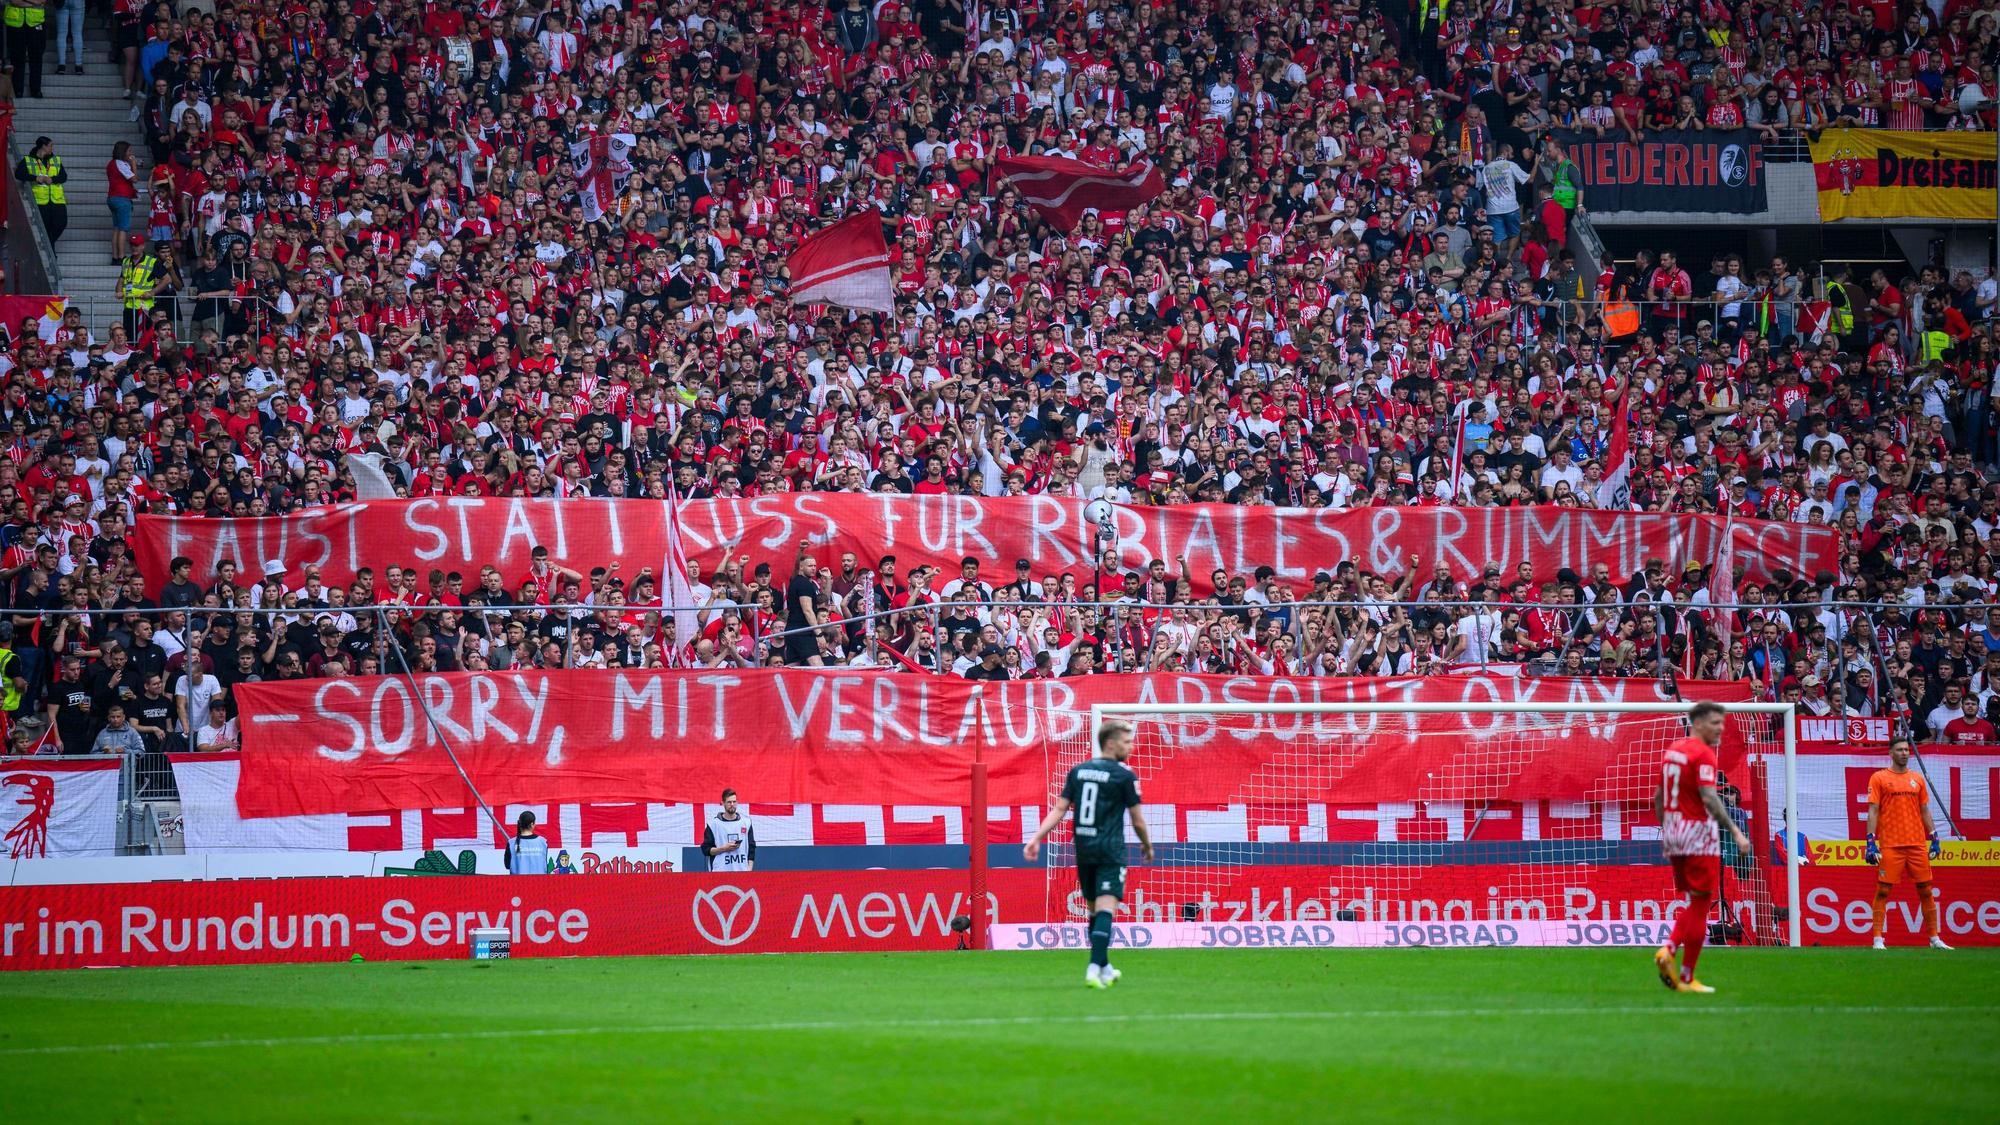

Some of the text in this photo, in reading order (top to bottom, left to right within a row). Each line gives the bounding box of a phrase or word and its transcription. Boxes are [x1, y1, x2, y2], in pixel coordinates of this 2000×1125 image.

[169, 502, 369, 577] FAUST
[662, 494, 838, 551] KUSS
[1030, 495, 1352, 578] RUBIALES
[1369, 507, 1404, 575] &
[1435, 507, 1833, 584] RUMMENIGGE
[314, 673, 566, 767] SORRY,
[610, 672, 742, 742] MIT
[774, 673, 1082, 748] VERLAUB
[1131, 676, 1424, 746] ABSOLUT
[1461, 675, 1626, 742] OKAY
[1079, 781, 1099, 826] 8
[1663, 763, 1681, 809] 17
[724, 854, 747, 865] SMF
[1487, 886, 1548, 921] im
[38, 907, 104, 956] im
[120, 896, 590, 952] Rundum-Service
[1200, 924, 1336, 947] JOBRAD
[1384, 923, 1519, 946] JOBRAD
[1566, 922, 1677, 945] JOBRA
